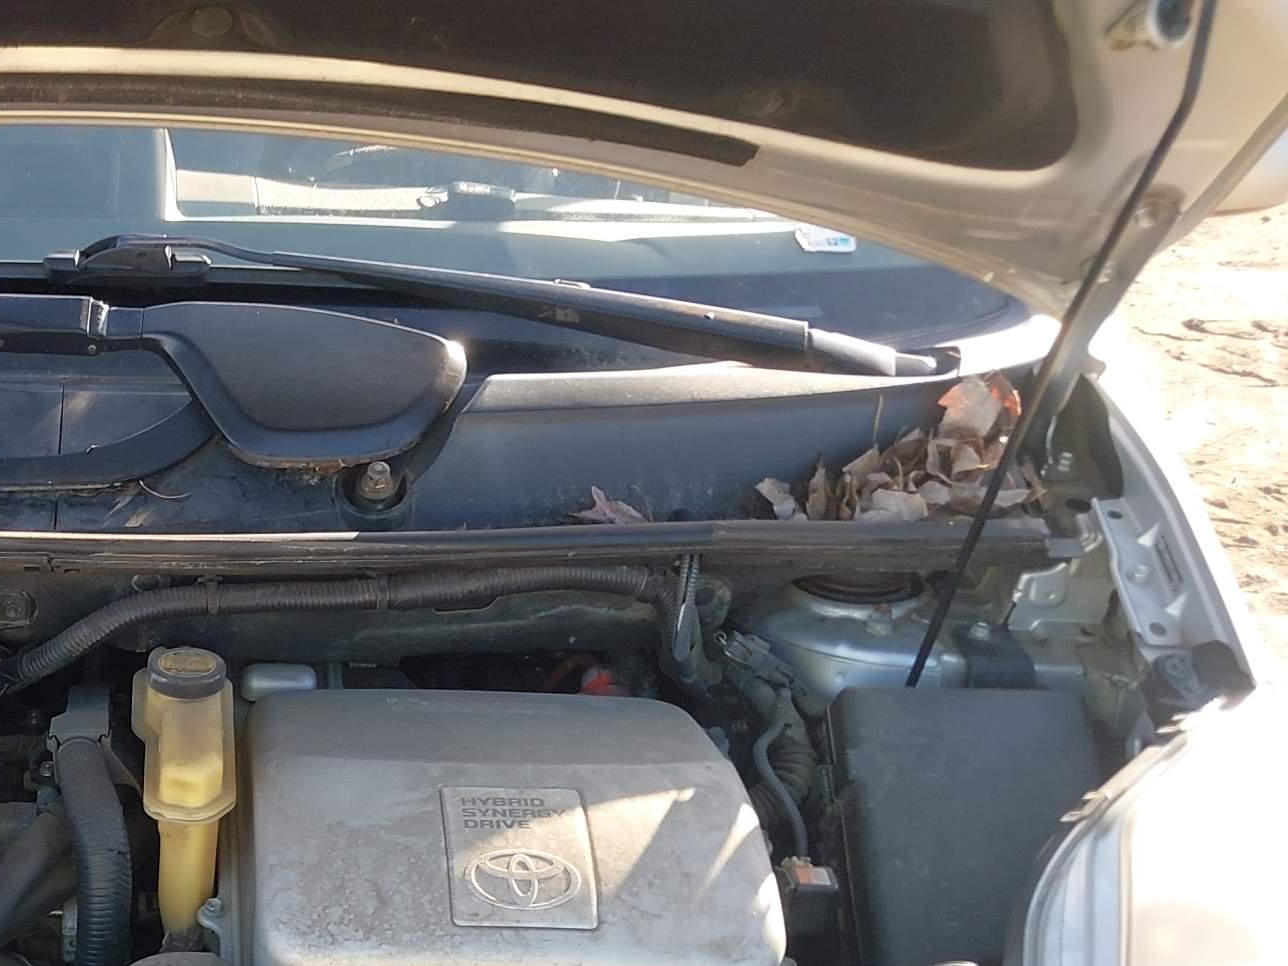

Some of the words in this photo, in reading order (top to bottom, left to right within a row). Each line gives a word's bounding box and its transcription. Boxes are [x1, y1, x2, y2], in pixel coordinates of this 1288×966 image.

[461, 797, 545, 807] HYBRID
[462, 809, 568, 818] SYNERGY
[464, 820, 531, 829] DRIVE
